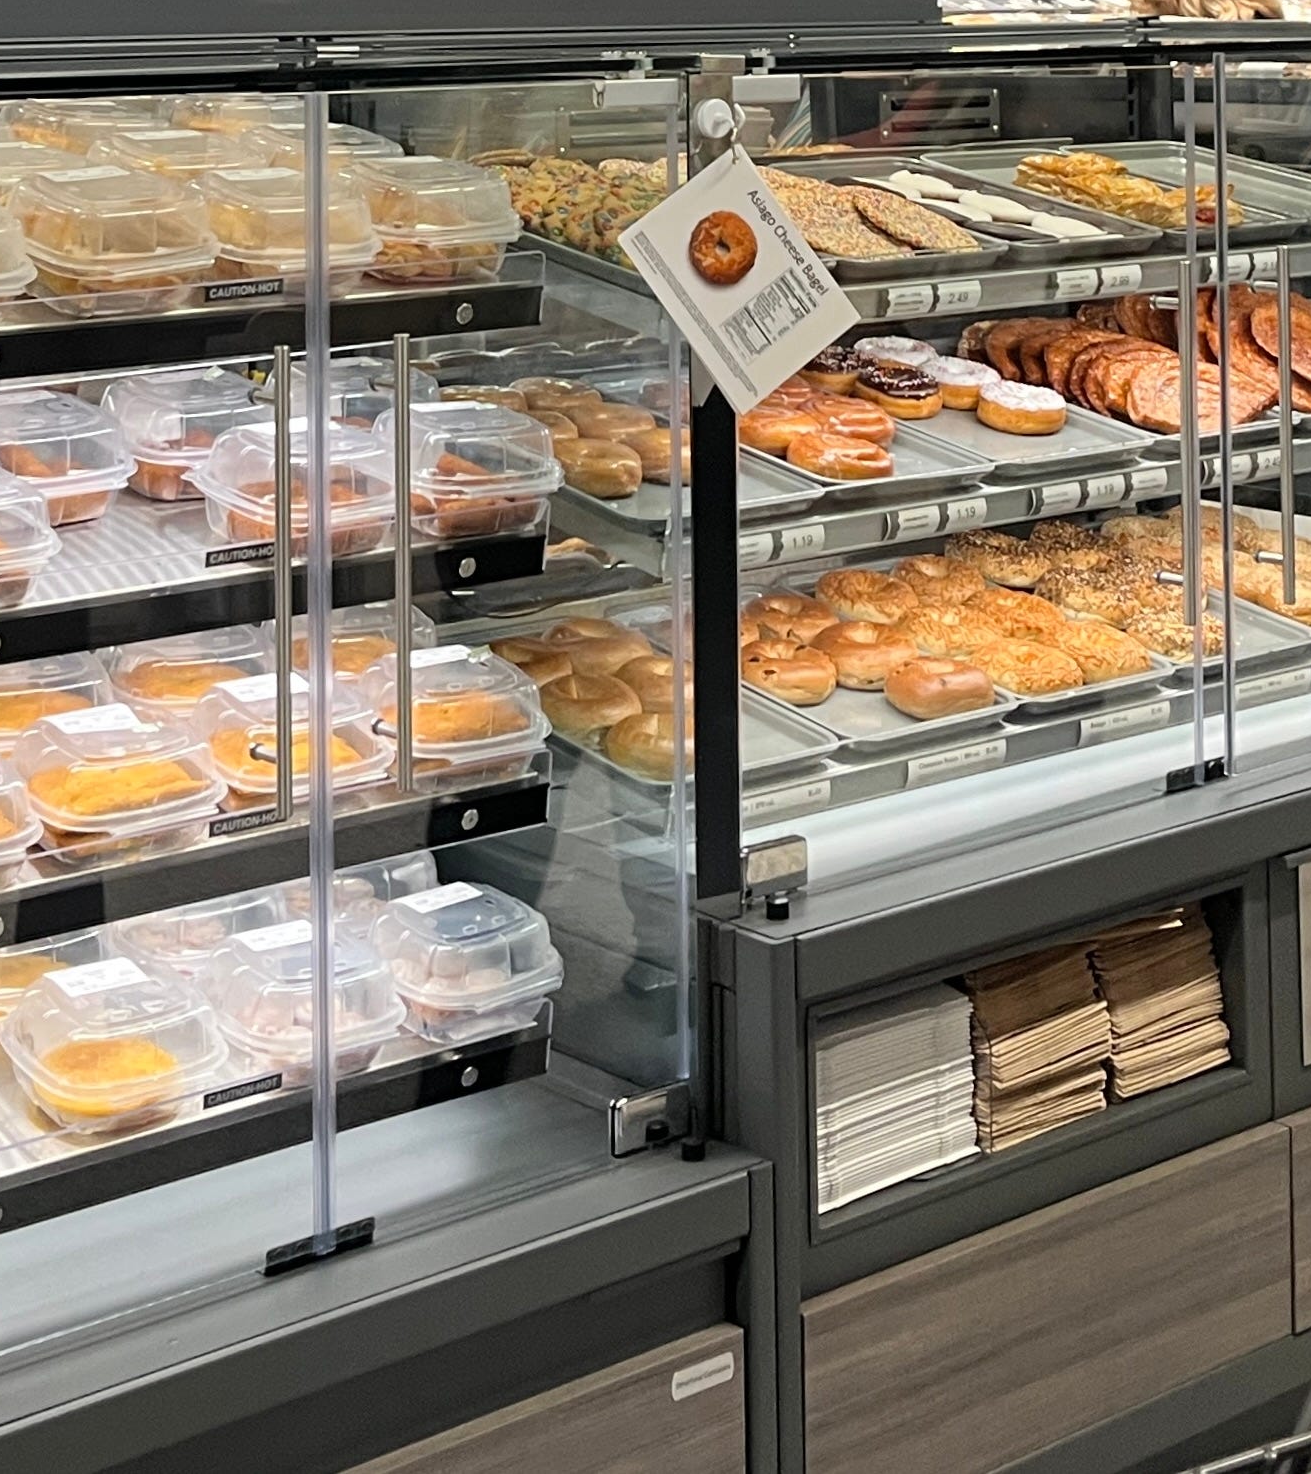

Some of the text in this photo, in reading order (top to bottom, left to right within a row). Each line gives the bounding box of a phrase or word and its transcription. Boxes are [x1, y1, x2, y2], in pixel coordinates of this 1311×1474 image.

[747, 190, 829, 297] Asiago Cheese Bagel
[209, 281, 280, 299] CAUTION-HOT
[947, 292, 969, 304] 2.49
[957, 506, 976, 519] 1.19
[793, 535, 813, 547] 1.19
[210, 545, 274, 564] CAUTION-HO
[213, 812, 276, 834] CAUTION-HO
[208, 1077, 278, 1105] CAUTION-HOT
